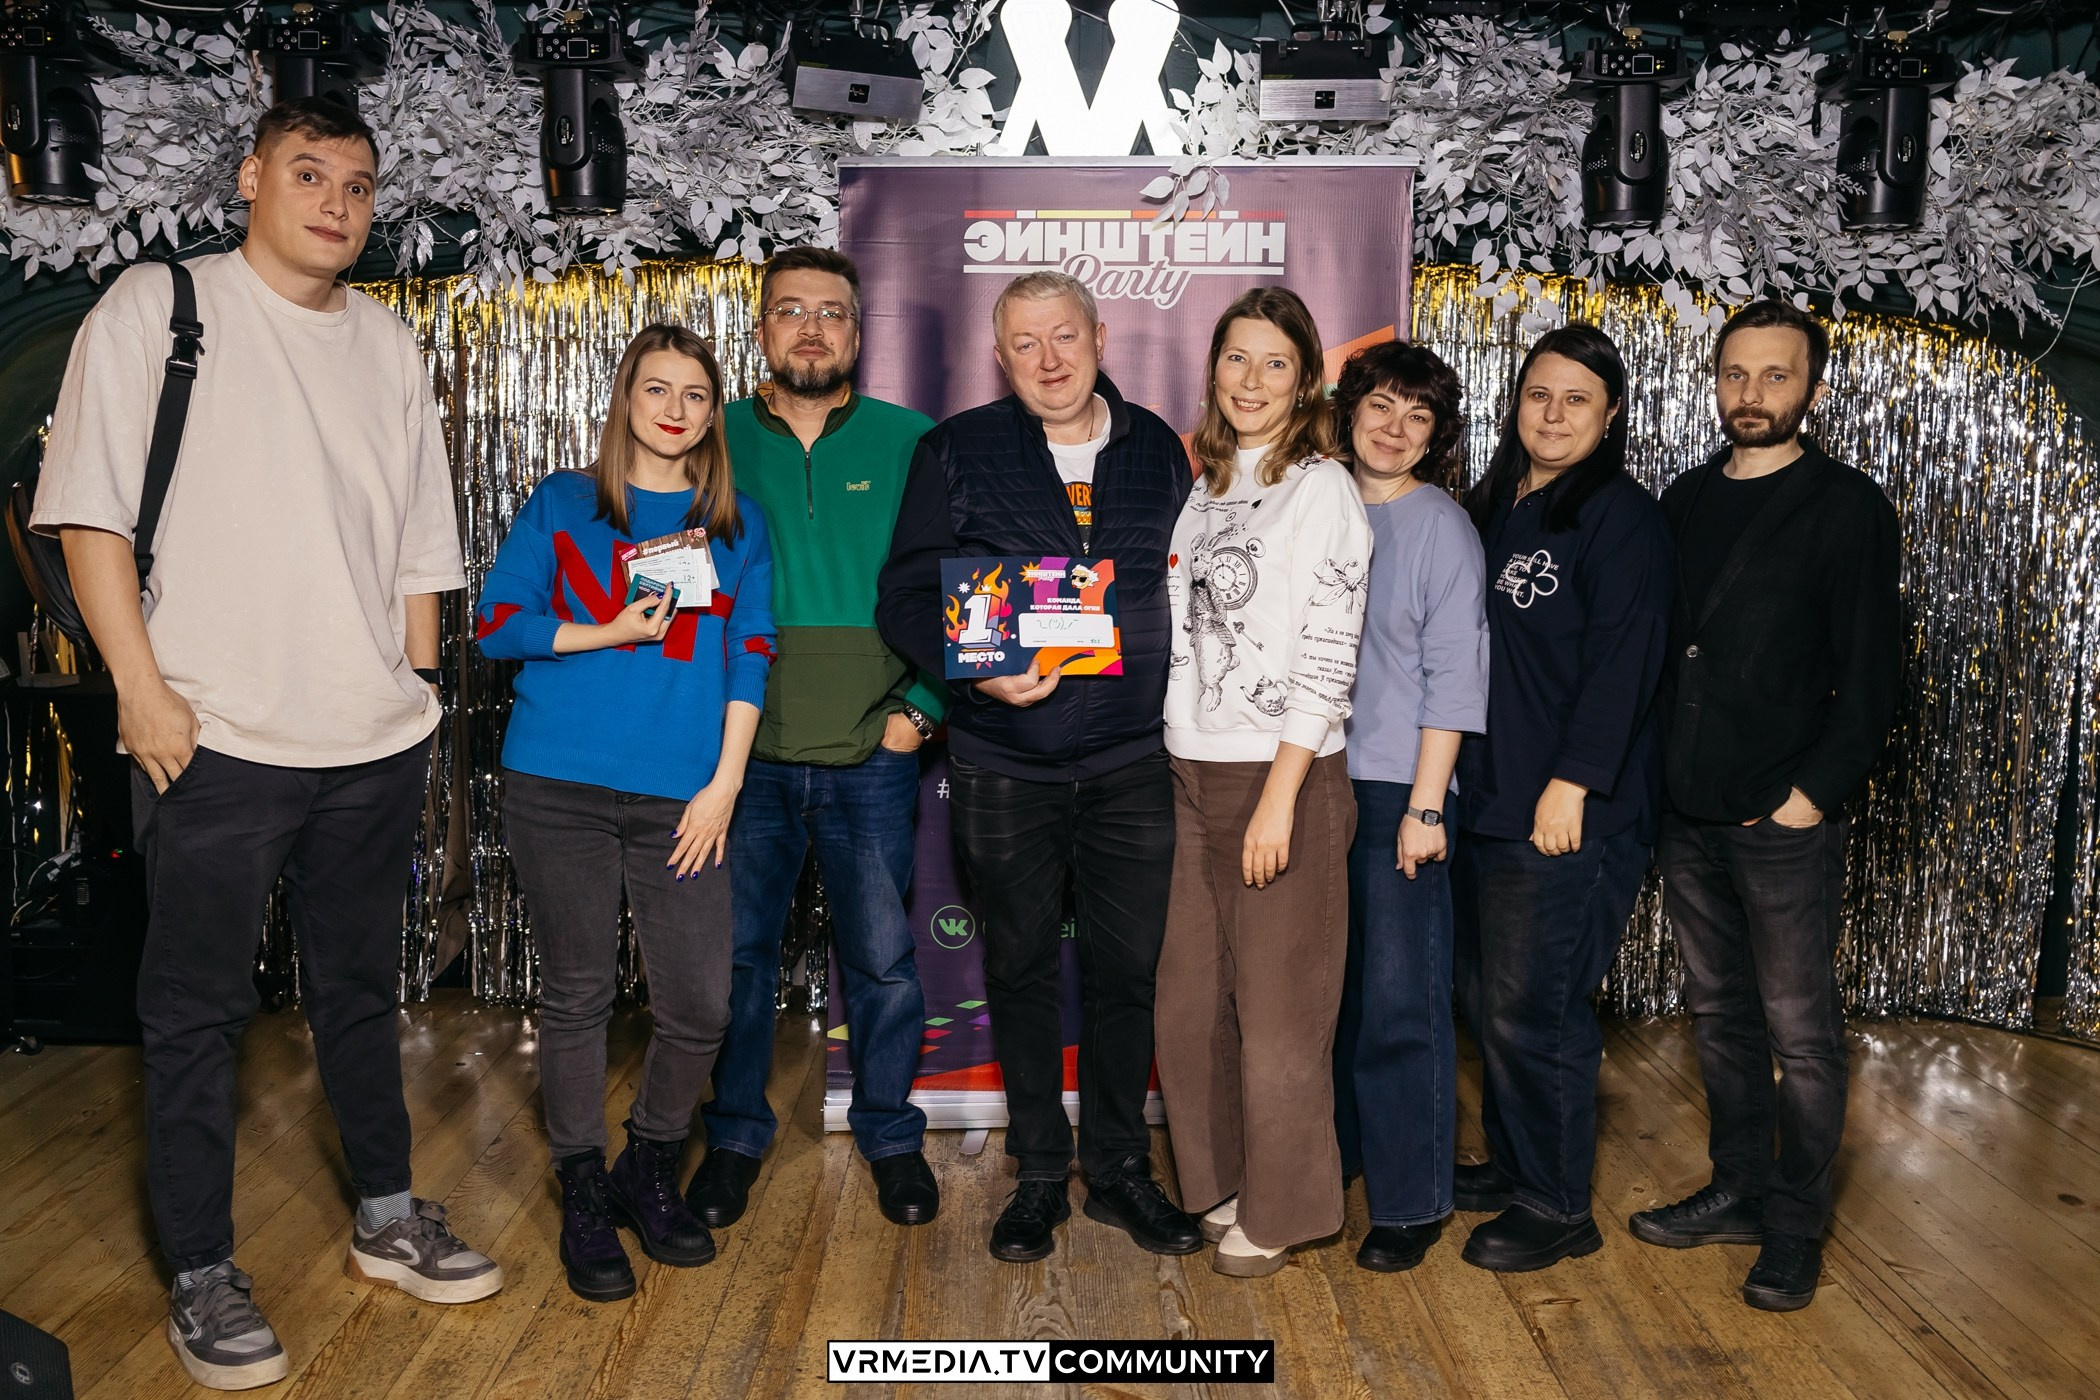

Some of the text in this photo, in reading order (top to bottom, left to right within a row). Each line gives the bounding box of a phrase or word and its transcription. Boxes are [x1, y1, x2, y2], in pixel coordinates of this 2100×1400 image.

[1062, 253, 1192, 309] Party
[959, 594, 1001, 650] 1
[958, 651, 1005, 663] МЕСТО
